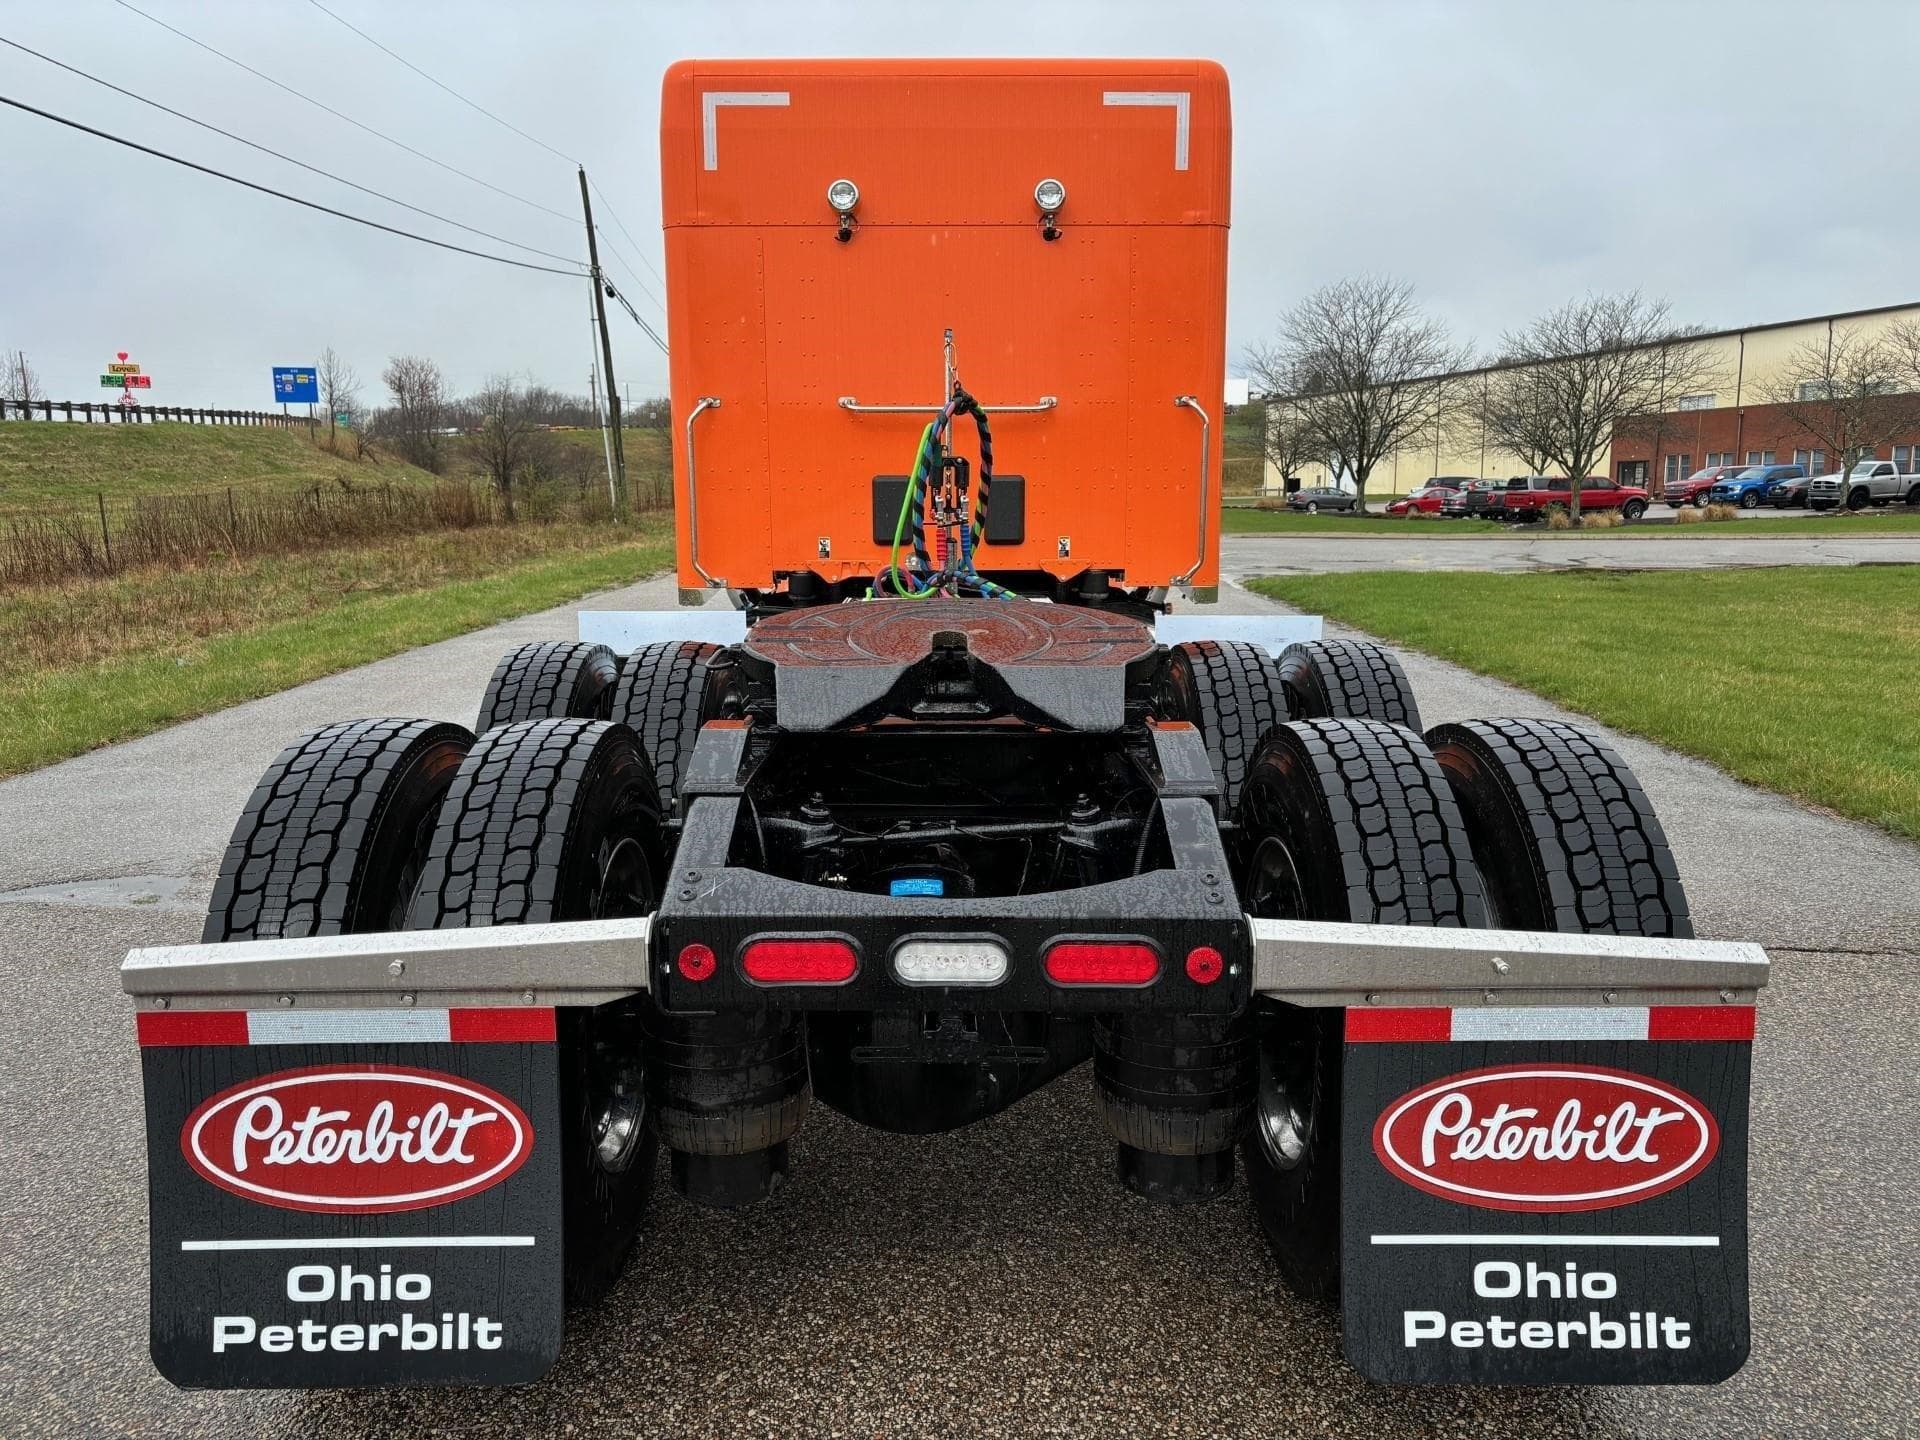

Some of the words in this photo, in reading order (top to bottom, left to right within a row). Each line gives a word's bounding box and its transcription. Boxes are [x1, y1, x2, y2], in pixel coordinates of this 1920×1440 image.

[232, 1095, 498, 1172] Peterbilt
[1421, 1092, 1685, 1168] Peterbilt
[286, 1264, 432, 1303] Ohio
[1473, 1261, 1618, 1300] Ohio
[212, 1313, 503, 1353] Peterbilt
[1403, 1311, 1692, 1350] Peterbilt
